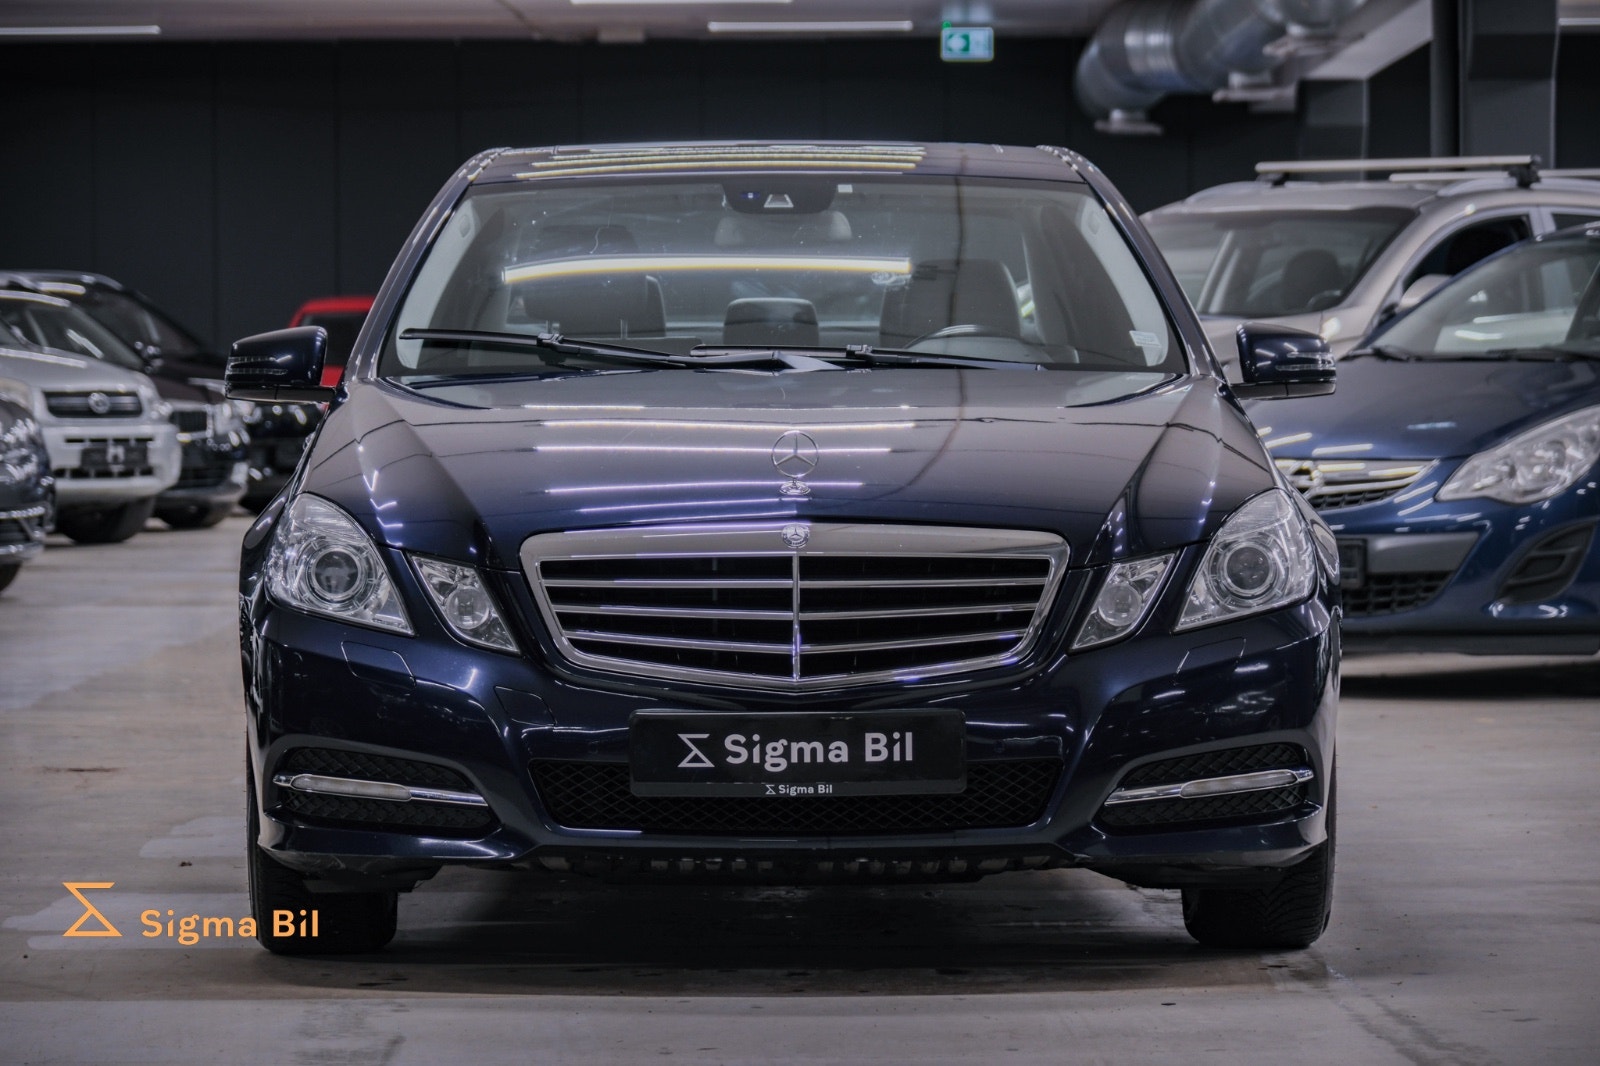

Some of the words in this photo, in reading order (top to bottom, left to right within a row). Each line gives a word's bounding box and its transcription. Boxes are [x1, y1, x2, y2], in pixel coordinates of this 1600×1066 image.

[724, 733, 849, 772] Sigma
[864, 731, 913, 762] Bil
[778, 784, 815, 797] Sigma
[817, 783, 833, 795] Bil
